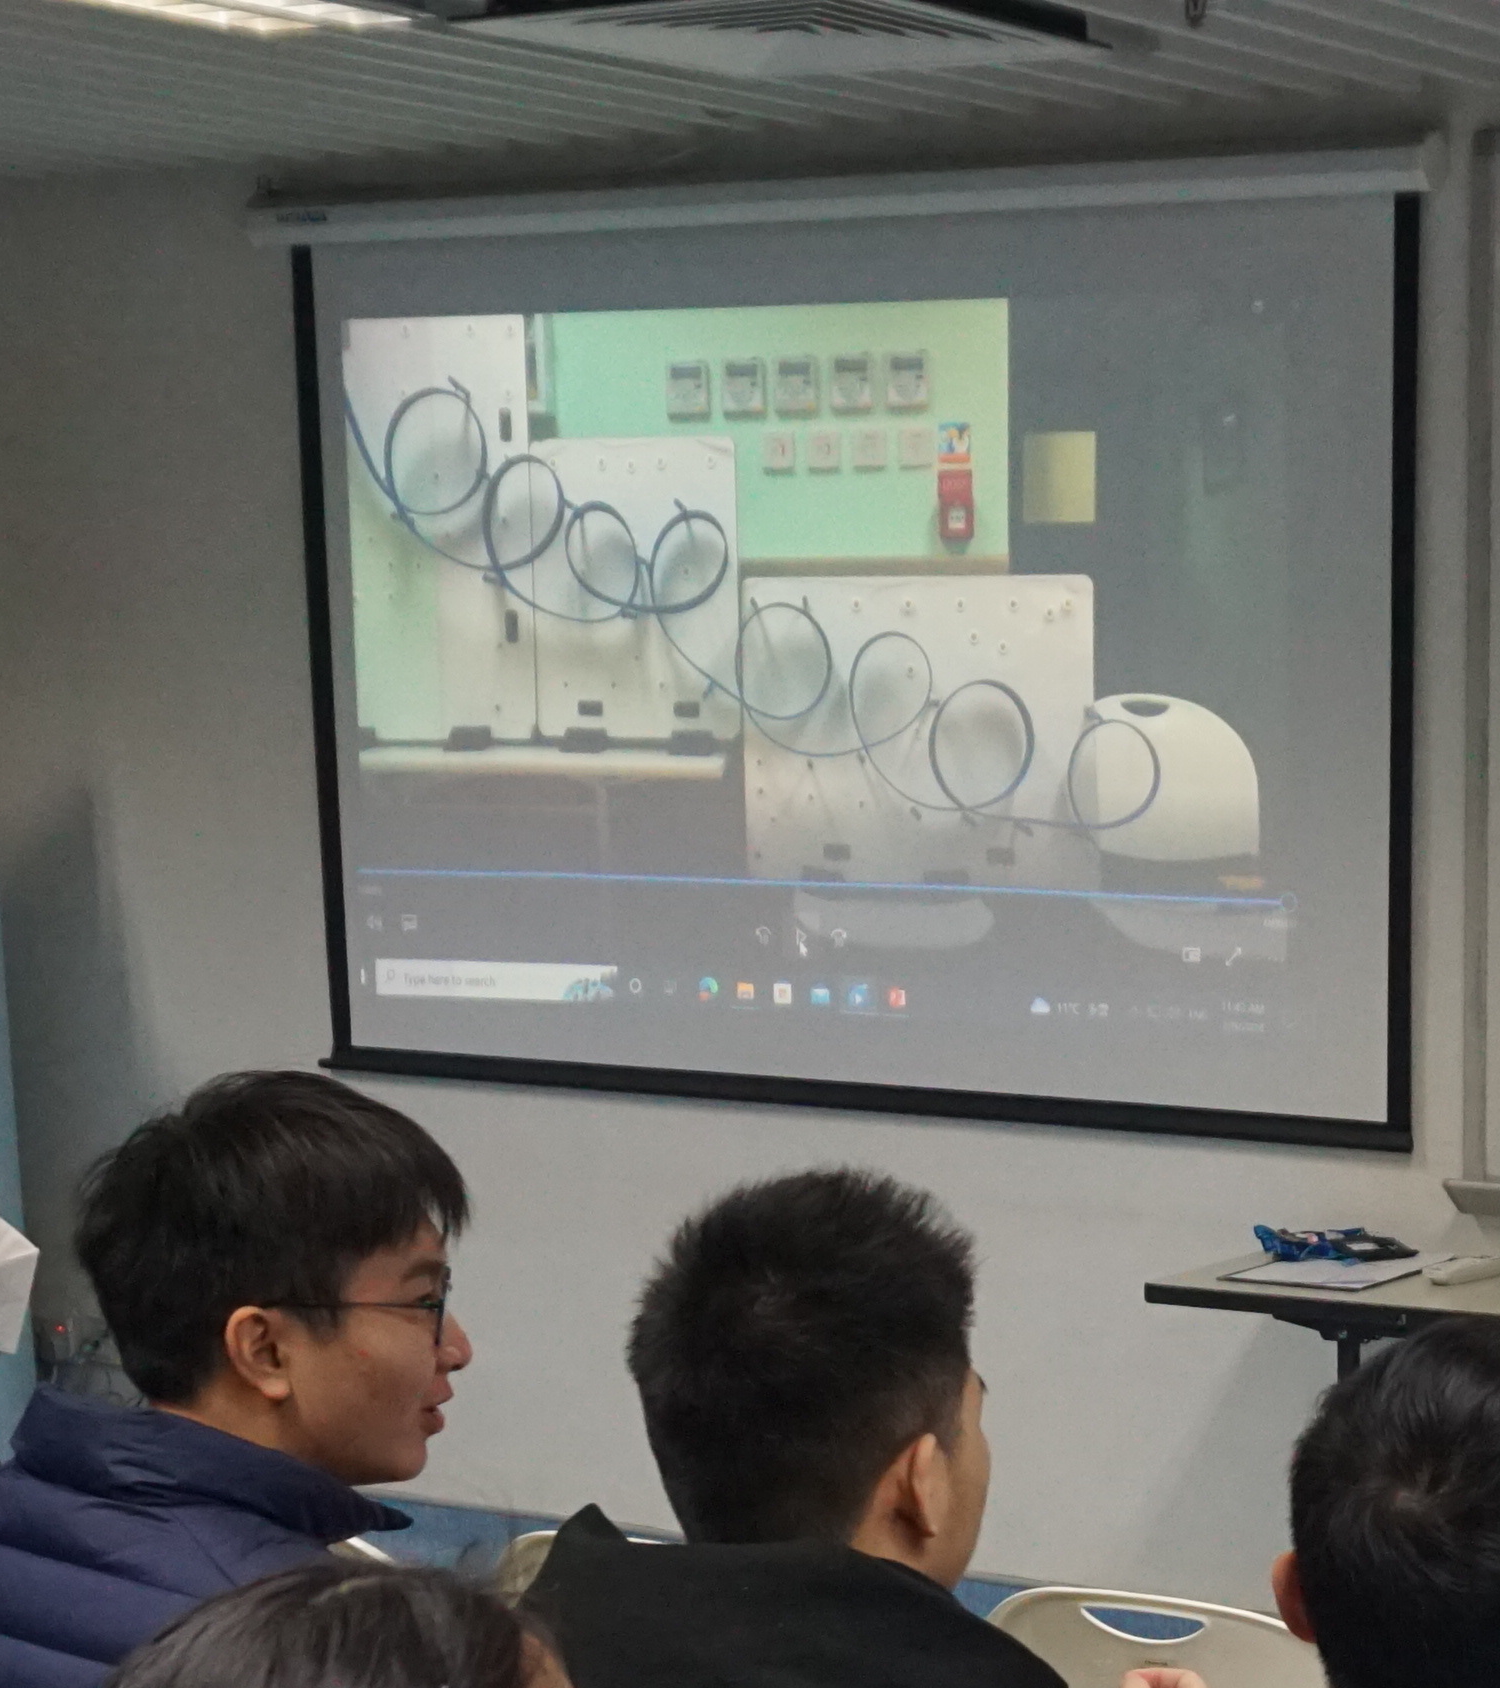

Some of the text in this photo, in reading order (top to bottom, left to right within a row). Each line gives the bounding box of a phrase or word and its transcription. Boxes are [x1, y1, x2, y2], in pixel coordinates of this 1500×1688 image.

[404, 973, 496, 988] Type here to search
